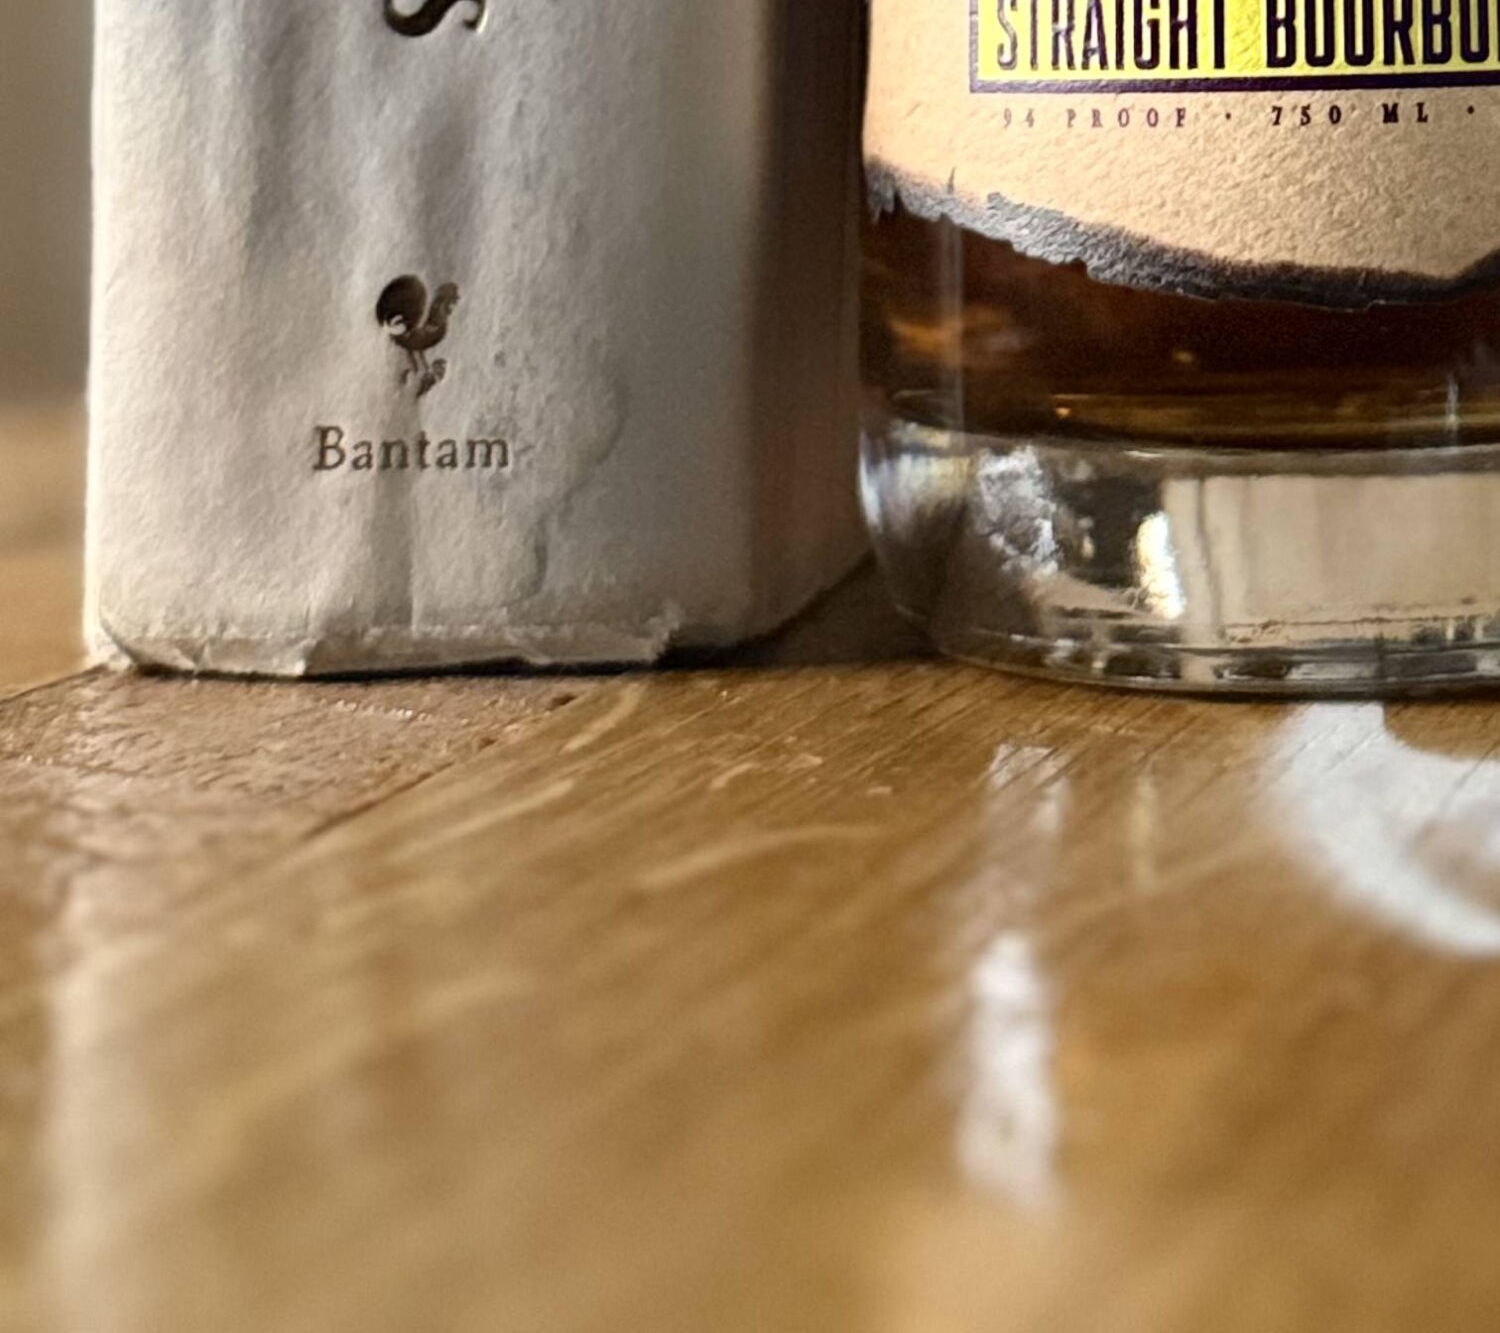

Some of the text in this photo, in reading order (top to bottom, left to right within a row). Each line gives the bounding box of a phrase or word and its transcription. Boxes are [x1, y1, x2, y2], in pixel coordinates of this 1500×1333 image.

[1003, 107, 1035, 128] 94
[1066, 106, 1187, 128] PROOF
[1271, 104, 1342, 126] 750
[1382, 101, 1429, 124] ML
[312, 425, 510, 471] Bantam
